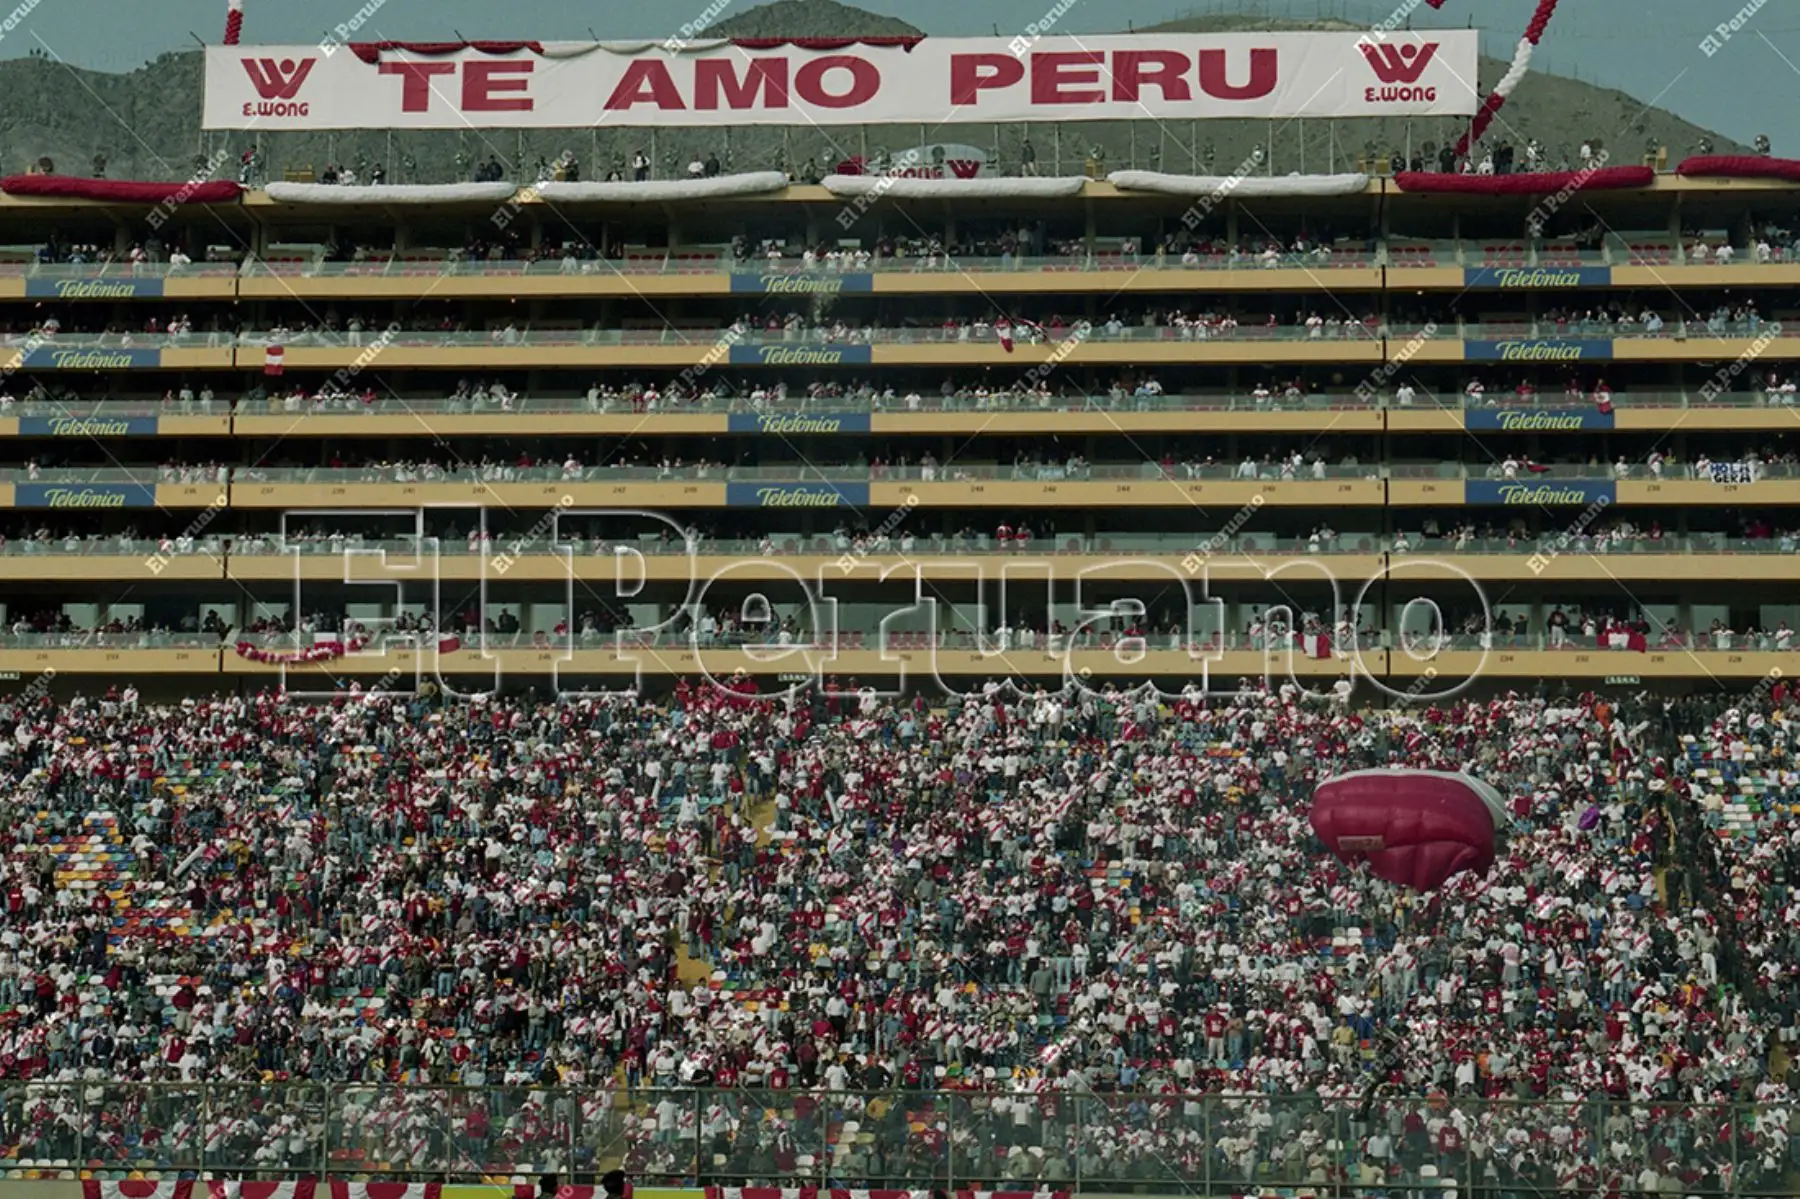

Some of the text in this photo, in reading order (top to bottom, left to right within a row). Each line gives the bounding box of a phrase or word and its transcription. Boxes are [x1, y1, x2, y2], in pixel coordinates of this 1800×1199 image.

[378, 47, 1278, 112] TE AMO PERU
